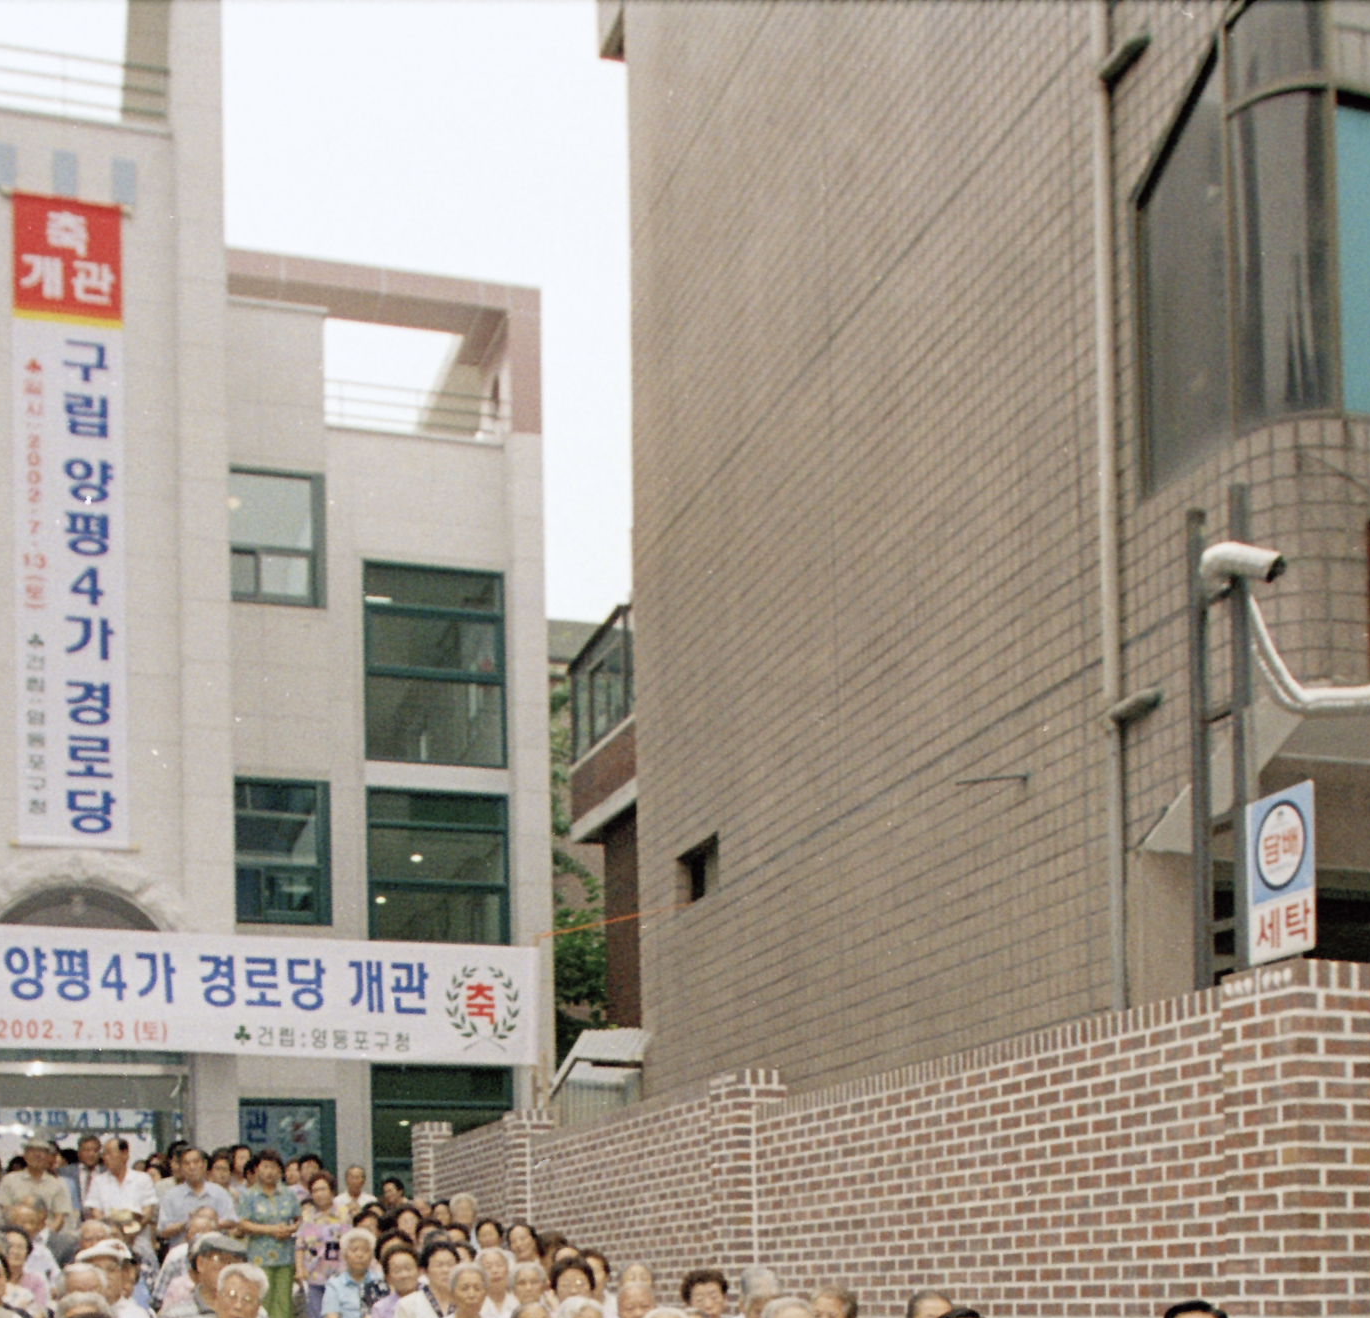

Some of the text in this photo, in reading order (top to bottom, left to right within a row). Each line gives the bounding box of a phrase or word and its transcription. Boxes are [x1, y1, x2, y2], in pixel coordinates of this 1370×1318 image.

[45, 210, 90, 258] 축
[19, 252, 116, 308] 개관
[64, 341, 117, 835] 구립 양평4가 경로당
[1257, 897, 1313, 949] 세탁
[4, 946, 178, 1004] 양평4가
[200, 954, 326, 1012] 경로당
[348, 959, 430, 1015] 개관
[463, 982, 498, 1027] 축
[101, 1019, 126, 1041] 13
